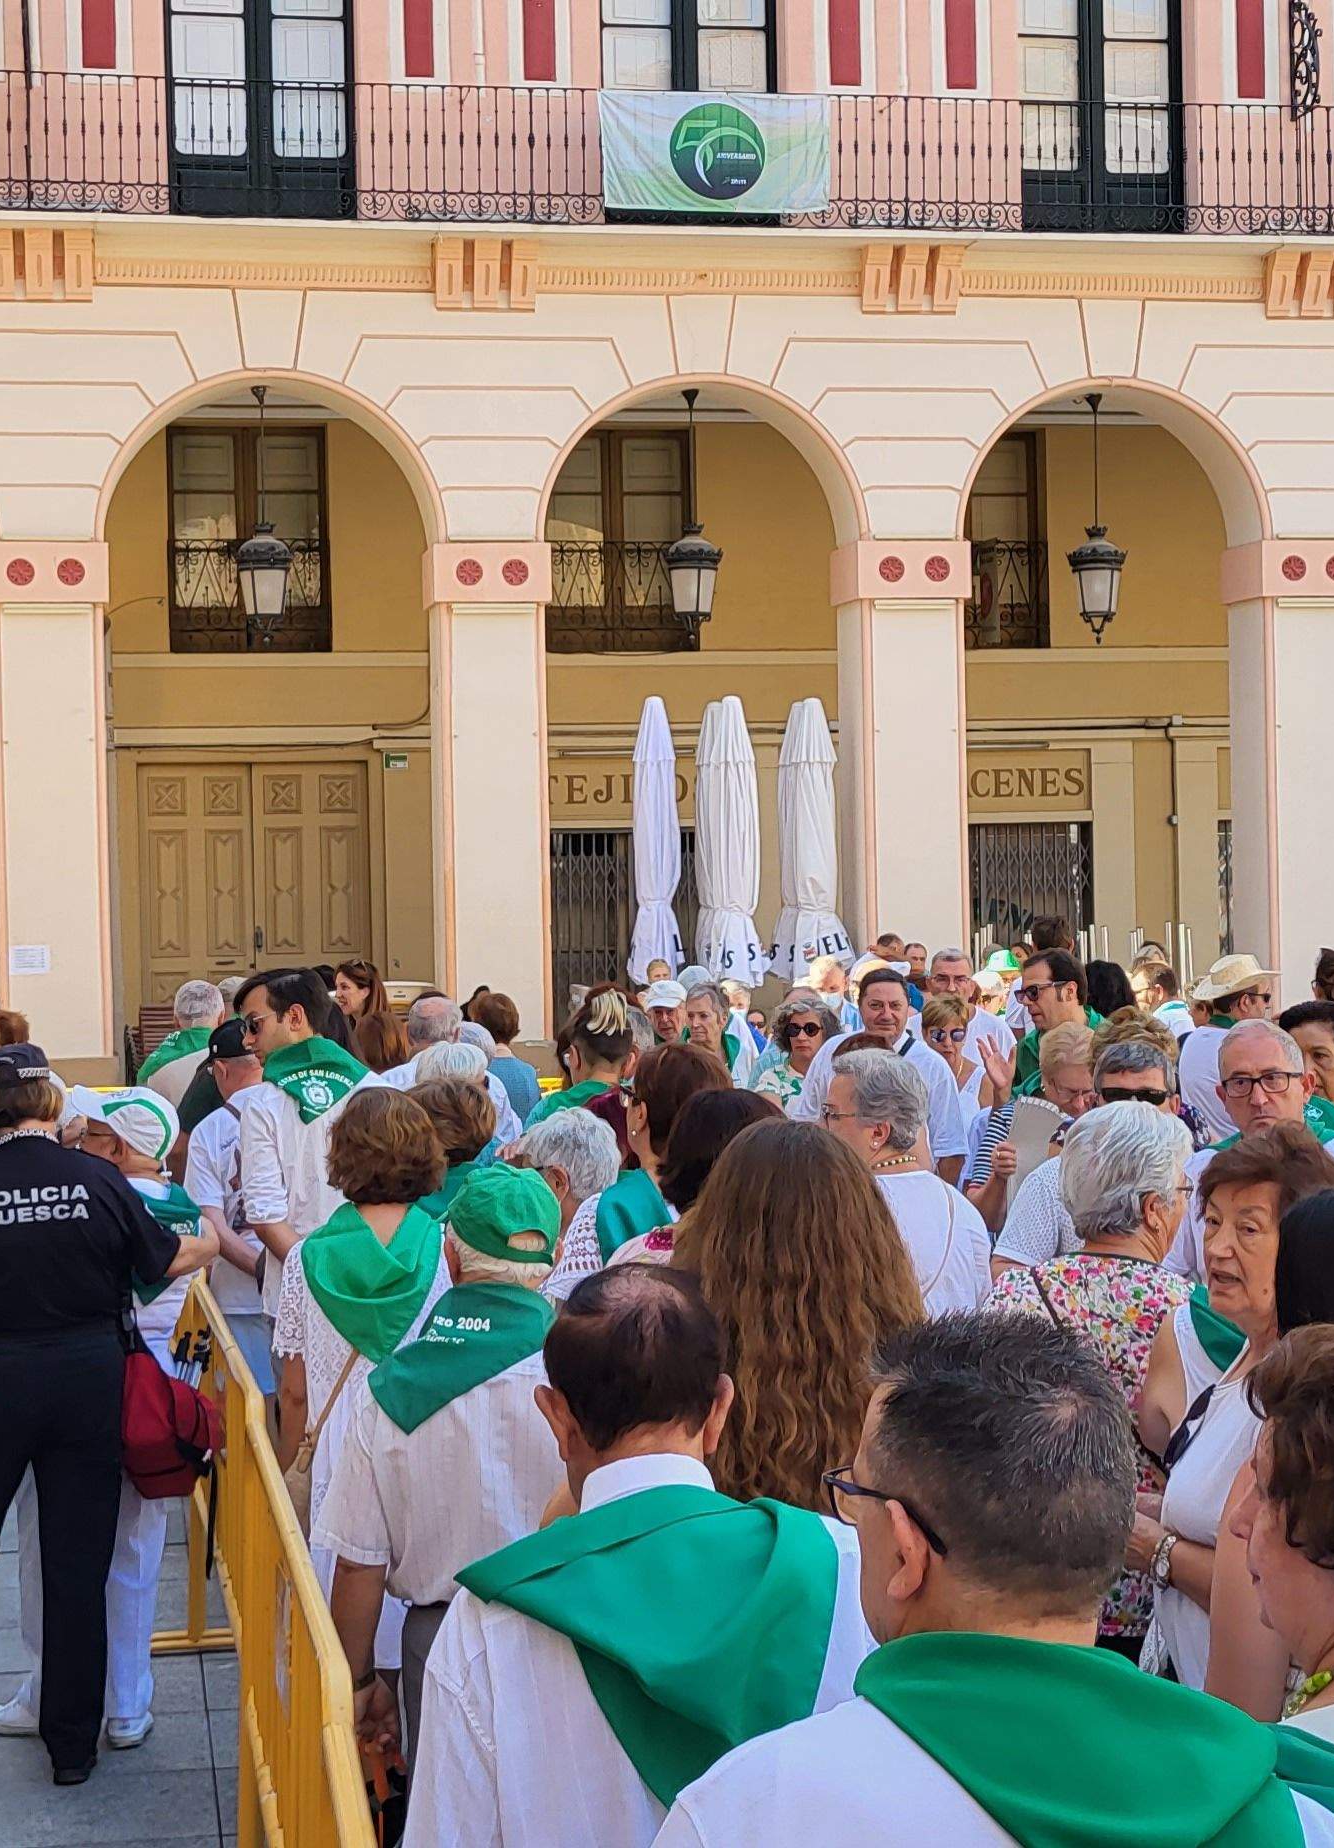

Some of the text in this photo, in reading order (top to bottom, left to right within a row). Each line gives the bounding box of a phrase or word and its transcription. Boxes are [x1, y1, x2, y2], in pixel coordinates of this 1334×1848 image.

[968, 768, 1085, 798] CENES
[309, 1069, 324, 1077] SAN
[456, 1316, 491, 1332] 2004
